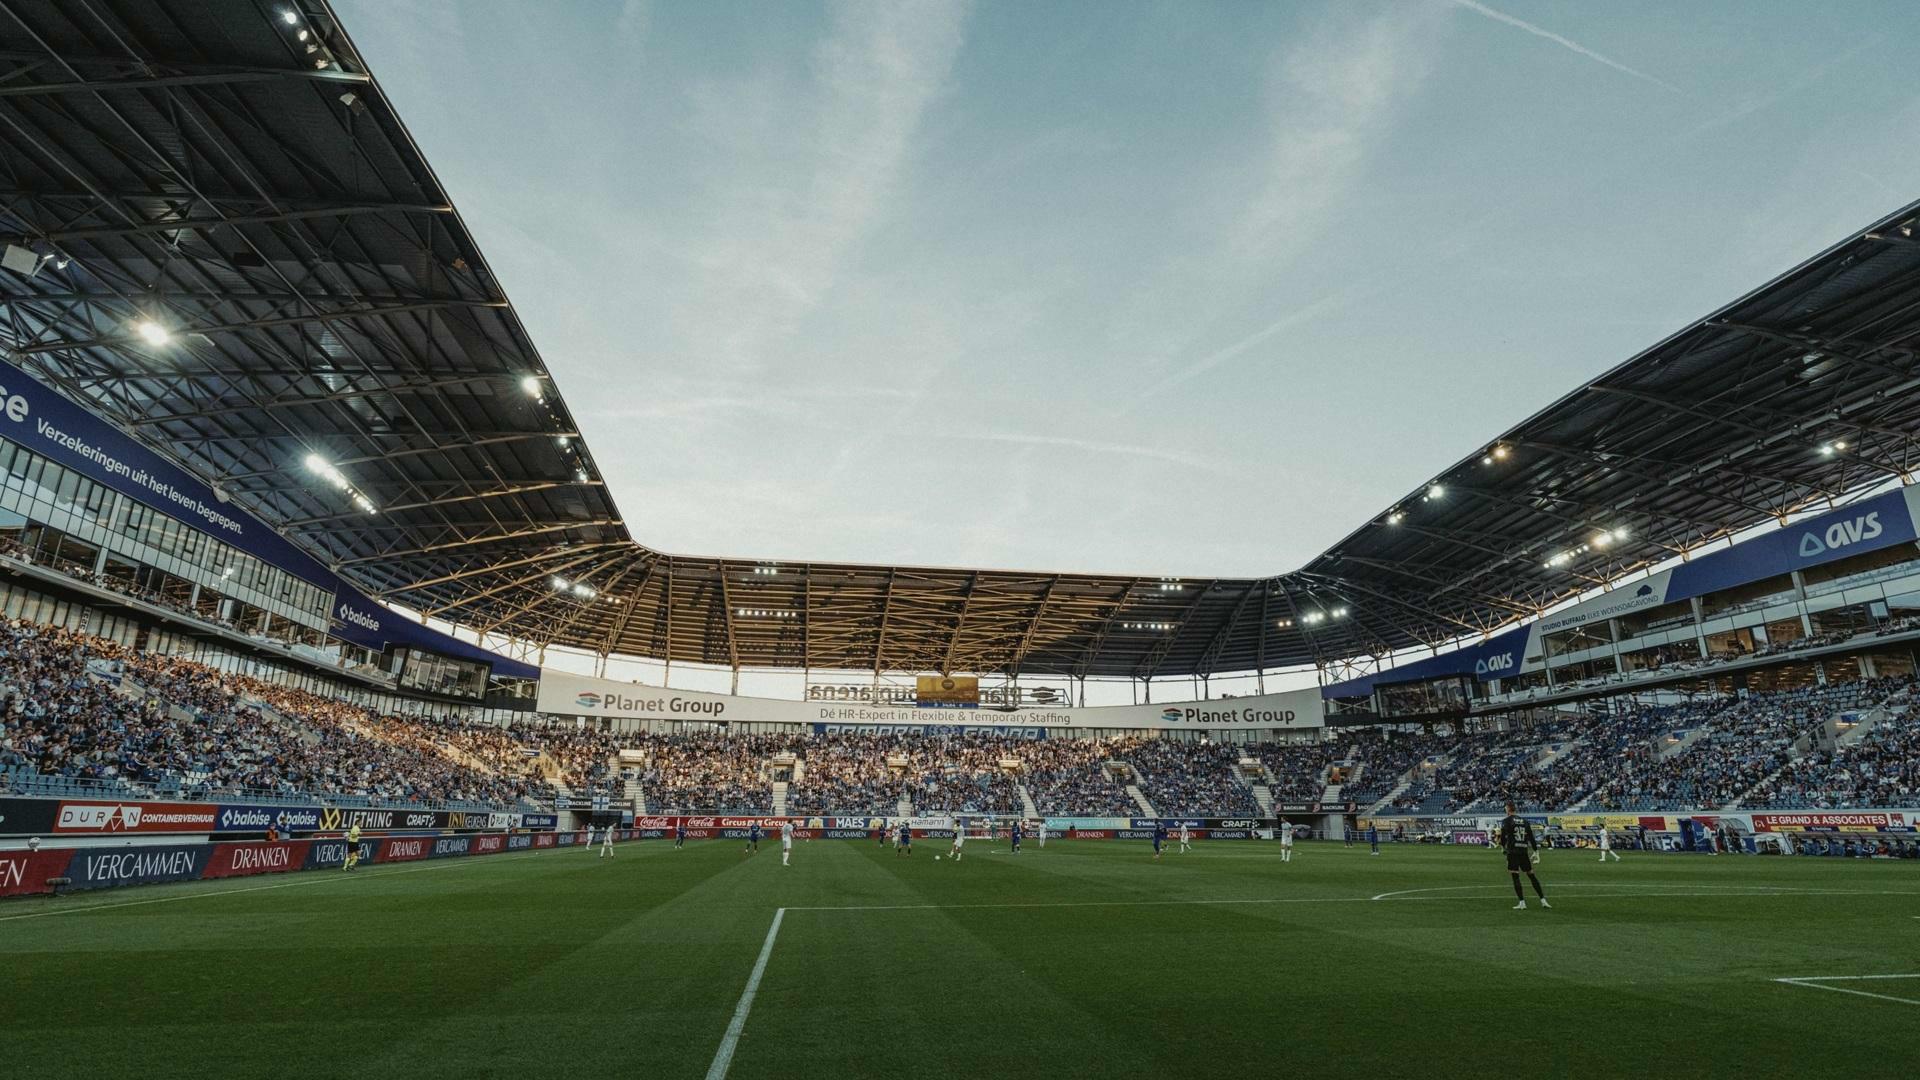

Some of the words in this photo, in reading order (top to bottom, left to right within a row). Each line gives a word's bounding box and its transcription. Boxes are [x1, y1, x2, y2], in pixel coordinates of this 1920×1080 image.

[37, 417, 130, 477] Verzekeringen
[131, 470, 148, 486] uit
[148, 476, 169, 497] het
[168, 486, 197, 511] leven
[196, 501, 243, 535] begrepen.
[347, 607, 380, 631] baloise
[1541, 621, 1562, 632] STUDIO
[1562, 614, 1587, 627] BUFFALO
[1600, 595, 1659, 616] WOENSDAGAVOND
[604, 693, 665, 712] Planet
[669, 697, 725, 717] Group
[820, 708, 836, 719] Dé
[838, 709, 895, 721] HR-Expert
[898, 709, 908, 719] in
[911, 709, 955, 720] Flexible
[957, 712, 966, 721] &
[970, 712, 1027, 724] Temporary
[1029, 712, 1071, 725] Staffing
[1185, 708, 1238, 723] Planet
[1243, 708, 1296, 725] Group
[62, 803, 139, 830] DURAN
[141, 813, 215, 823] CONTAINERVERHUUR
[233, 809, 271, 825] baloise
[286, 811, 317, 825] baloise
[406, 814, 430, 826] CRAFT
[721, 818, 746, 827] Circus
[836, 818, 865, 828] MAES
[1221, 820, 1251, 828] CRAFT
[1766, 816, 1778, 825] LE
[1779, 816, 1808, 825] GRAND
[1809, 815, 1820, 825] &
[1822, 815, 1886, 825] ASSOCIATES
[389, 841, 422, 857] DRANKEN
[436, 838, 469, 854] VERCAMMEN
[478, 837, 500, 850] DRANKEN
[231, 847, 290, 870] DRANKEN
[316, 843, 372, 863] VERCAEN
[87, 851, 196, 881] VERCAMMEN
